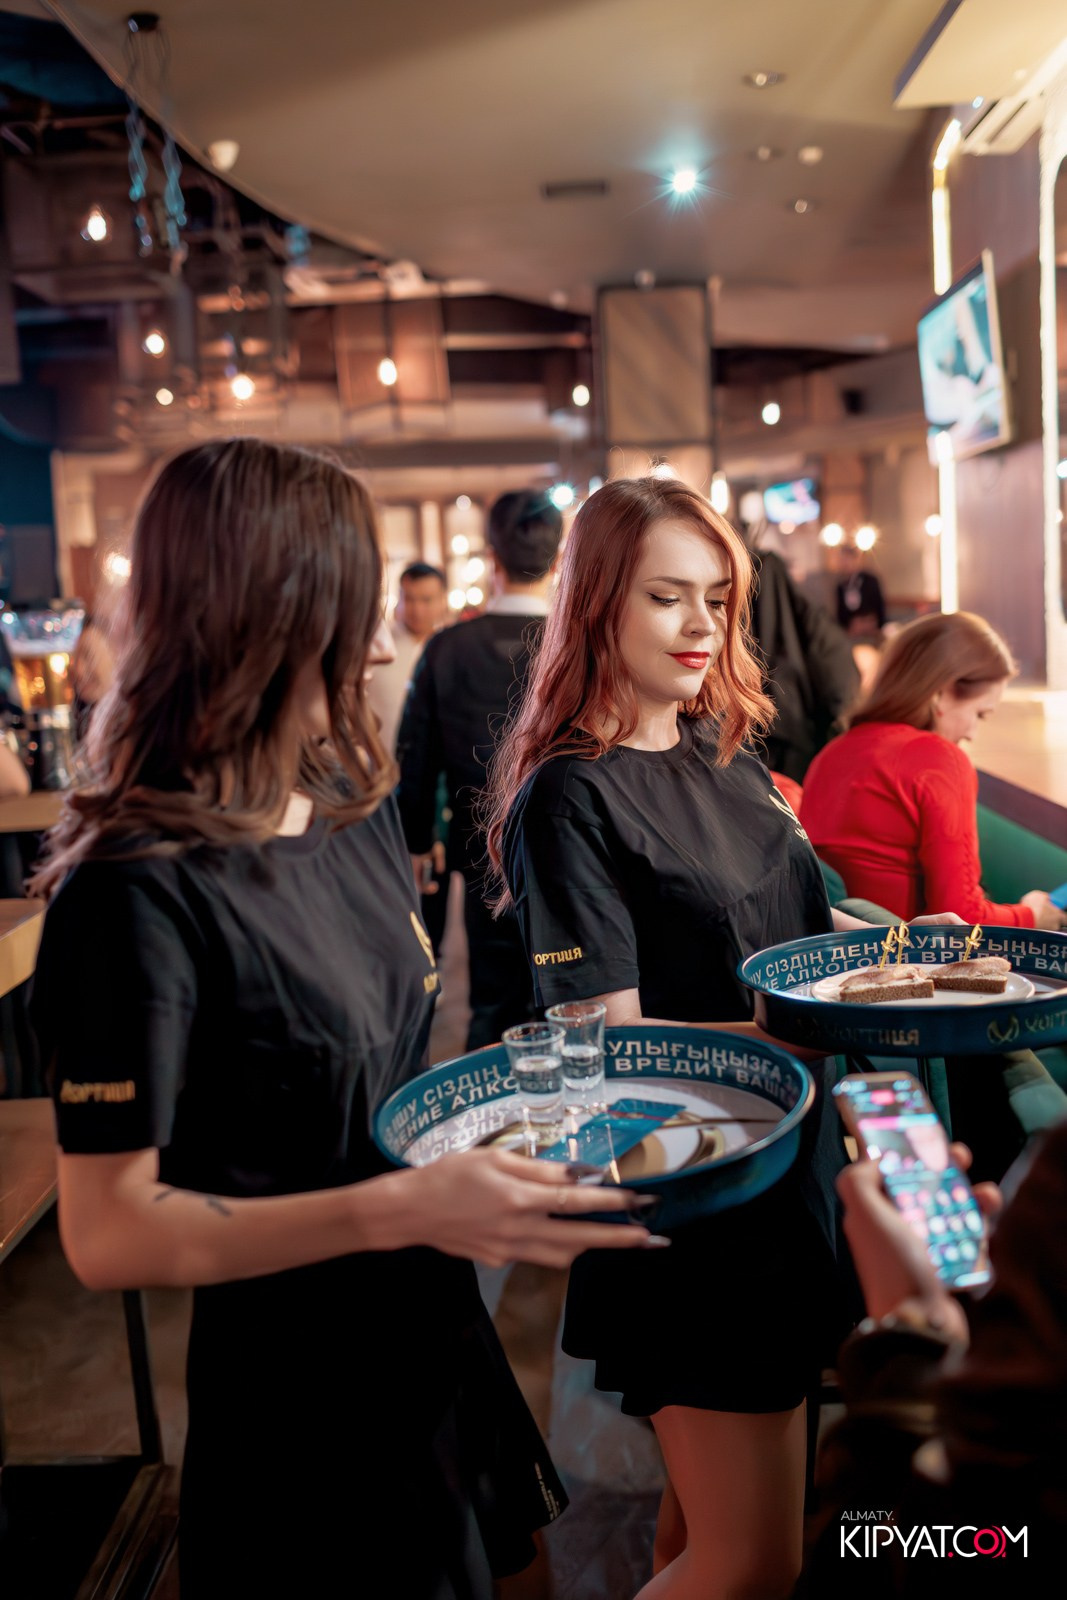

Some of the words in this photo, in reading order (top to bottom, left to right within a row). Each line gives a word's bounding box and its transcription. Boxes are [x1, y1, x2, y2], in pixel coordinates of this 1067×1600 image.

[532, 946, 583, 966] ОРТИЦЯ
[1034, 957, 1067, 973] ВА
[614, 1057, 727, 1079] ВРЕДИТ
